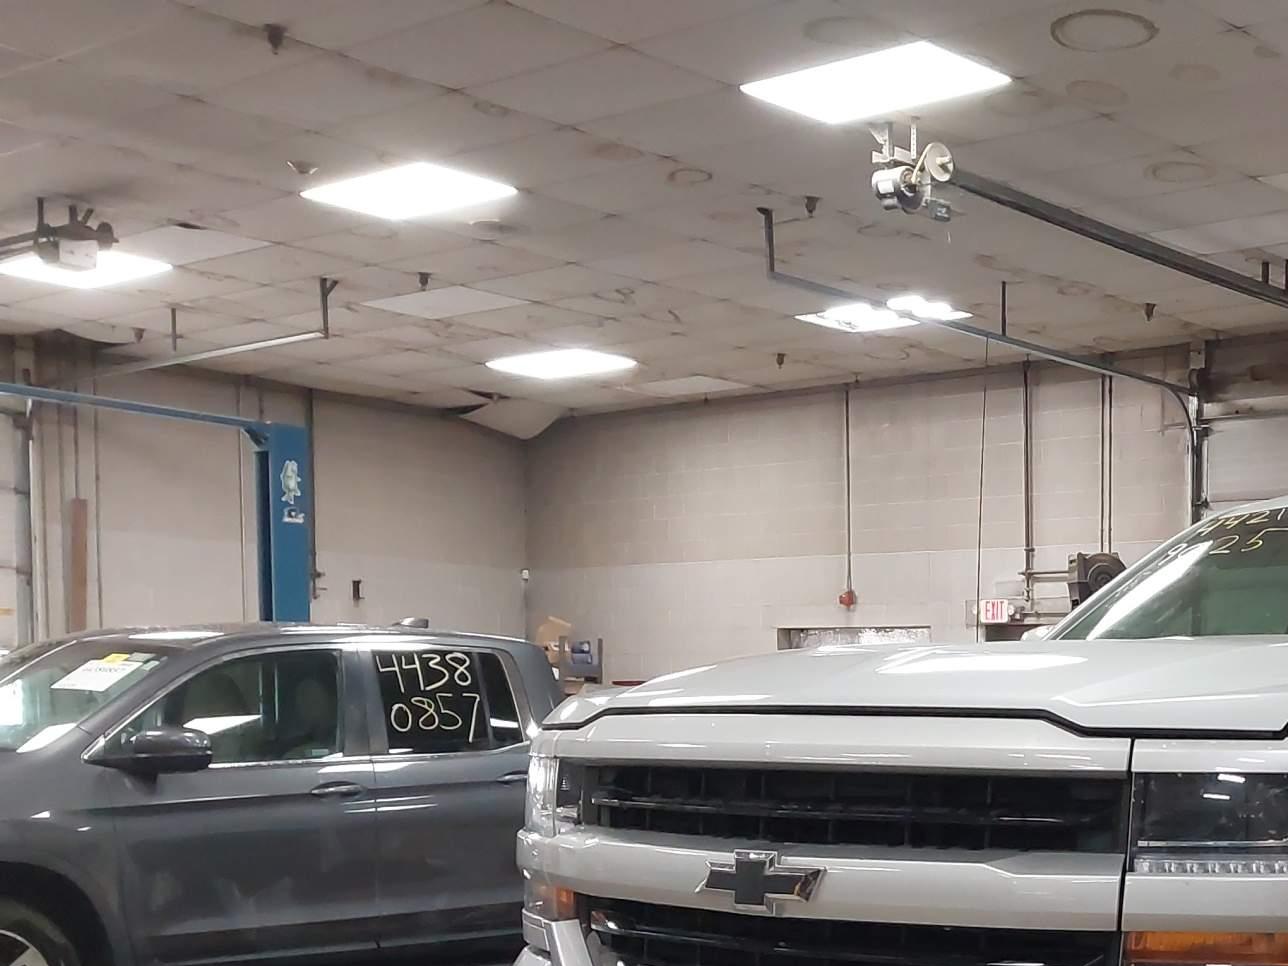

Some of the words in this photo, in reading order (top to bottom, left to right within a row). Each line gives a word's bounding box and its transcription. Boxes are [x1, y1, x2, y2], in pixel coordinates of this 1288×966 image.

[985, 600, 1005, 620] EXIT
[375, 651, 472, 693] 4438
[390, 692, 480, 743] 0857
